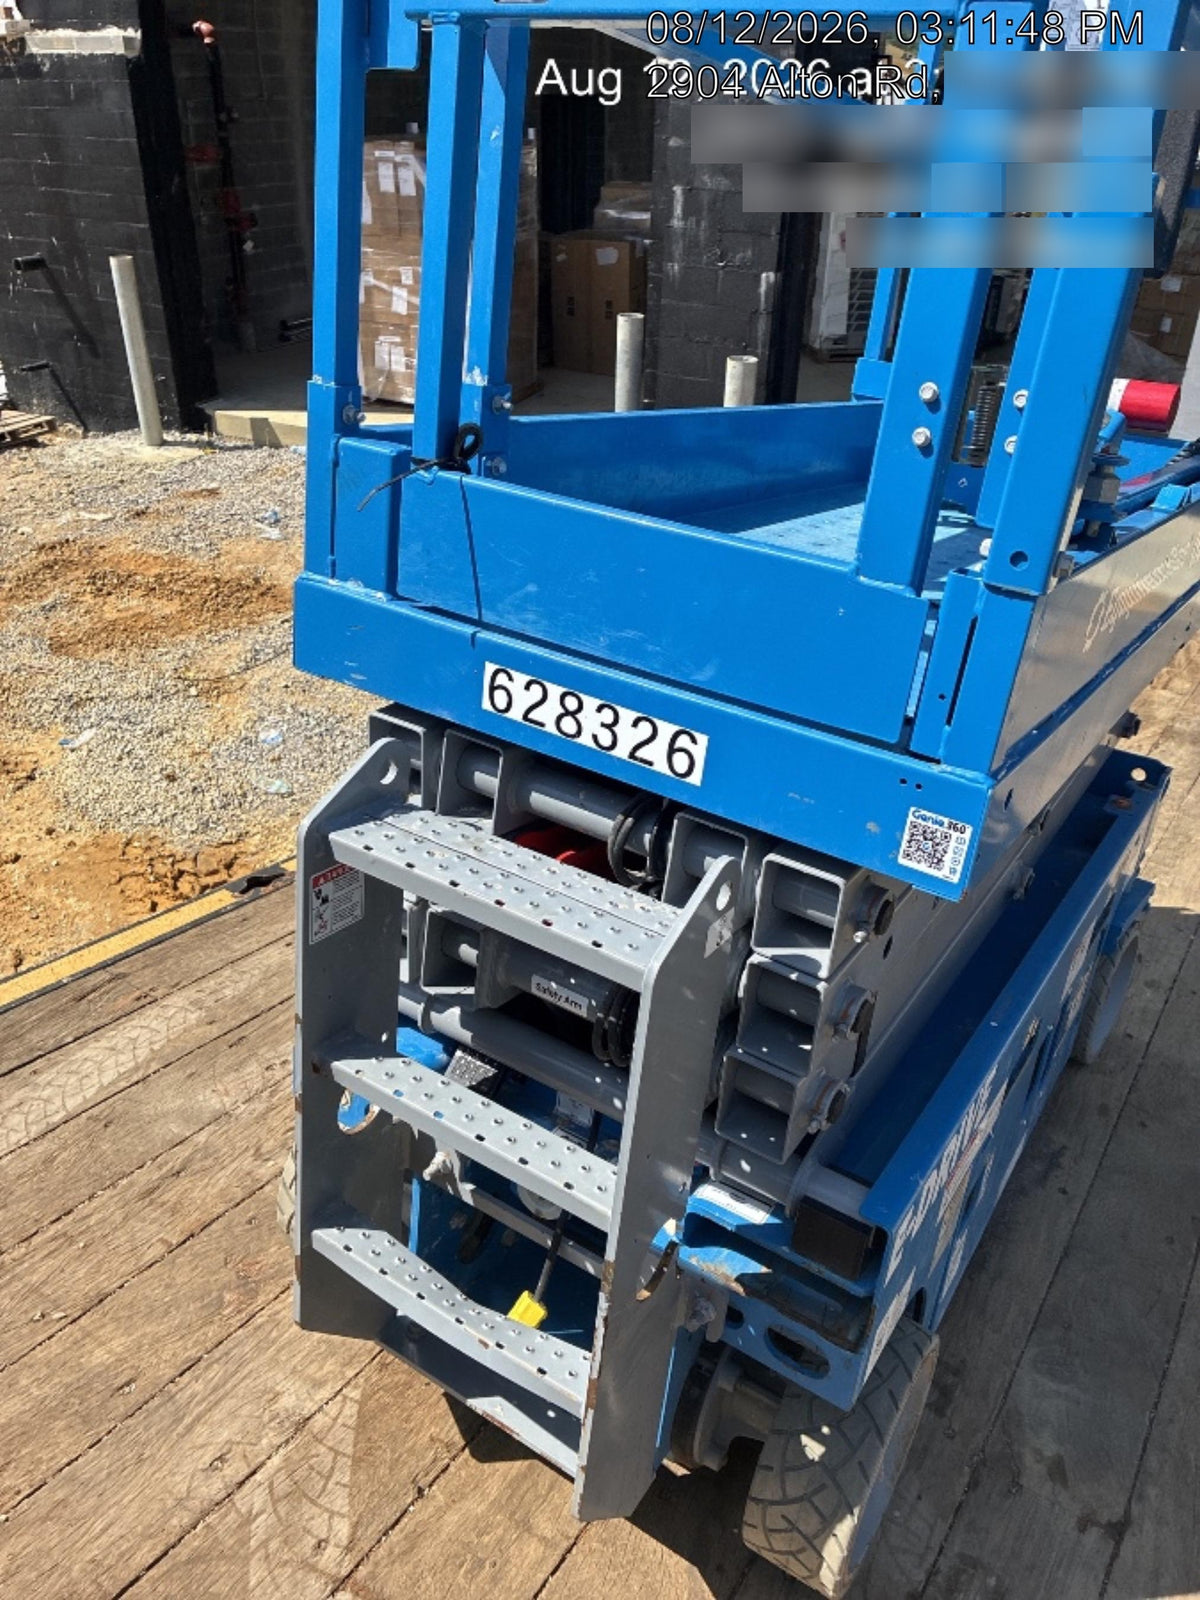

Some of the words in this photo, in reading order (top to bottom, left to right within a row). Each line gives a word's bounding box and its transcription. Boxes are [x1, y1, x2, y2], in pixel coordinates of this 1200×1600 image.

[488, 667, 698, 779] 628326
[536, 982, 563, 1003] Safety
[563, 996, 582, 1010] Arm
